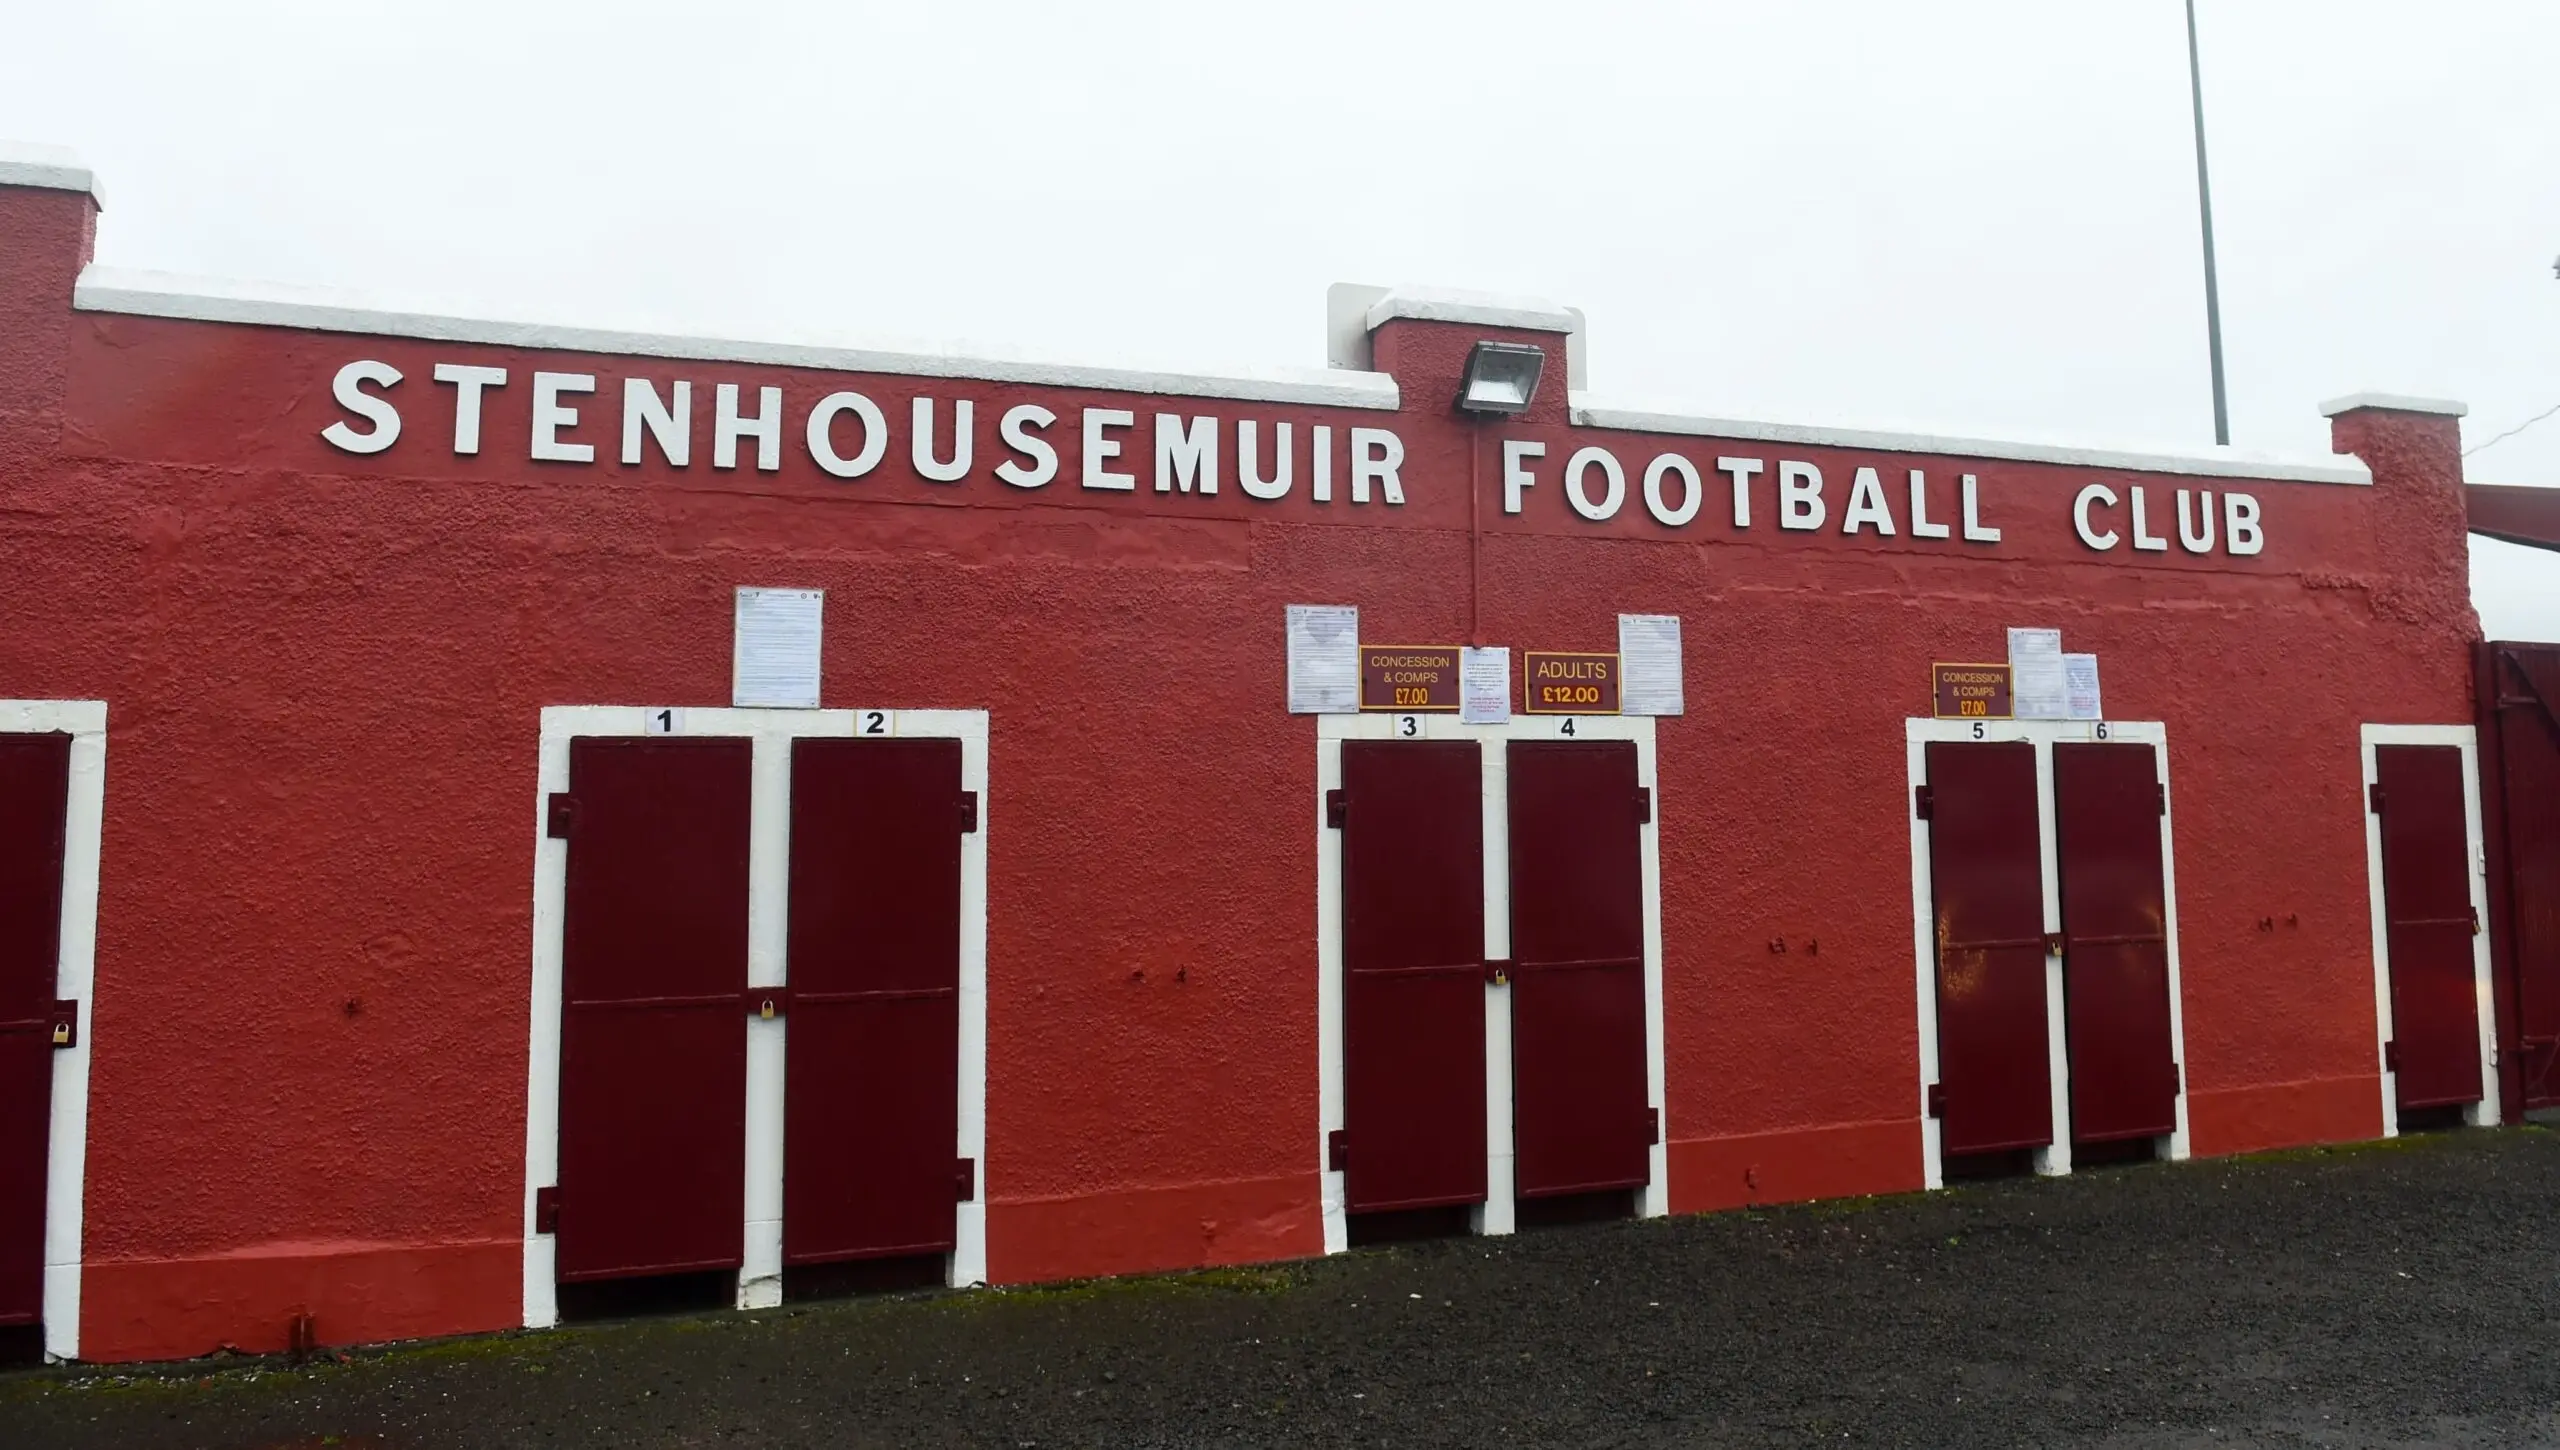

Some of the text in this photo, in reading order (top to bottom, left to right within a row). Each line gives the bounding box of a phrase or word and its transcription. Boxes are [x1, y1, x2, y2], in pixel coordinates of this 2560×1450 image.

[321, 360, 2265, 556] STENHOUSEMUIR FOOTBALL CLUB
[1371, 656, 1450, 668] CONCESSION
[1538, 661, 1607, 679] ADULTS
[1383, 672, 1438, 683] & COMPS
[1942, 672, 2003, 684] CONCESSION
[1395, 687, 1428, 705] £7.00
[1543, 686, 1599, 703] £12.00
[1953, 687, 1995, 697] & COMPS
[1960, 700, 1986, 716] £7.00
[657, 710, 671, 732] 1
[867, 712, 884, 733] 2
[1402, 716, 1417, 736] 3
[1560, 717, 1576, 737] 4
[1972, 722, 1984, 739] 5
[2096, 722, 2108, 740] 6
